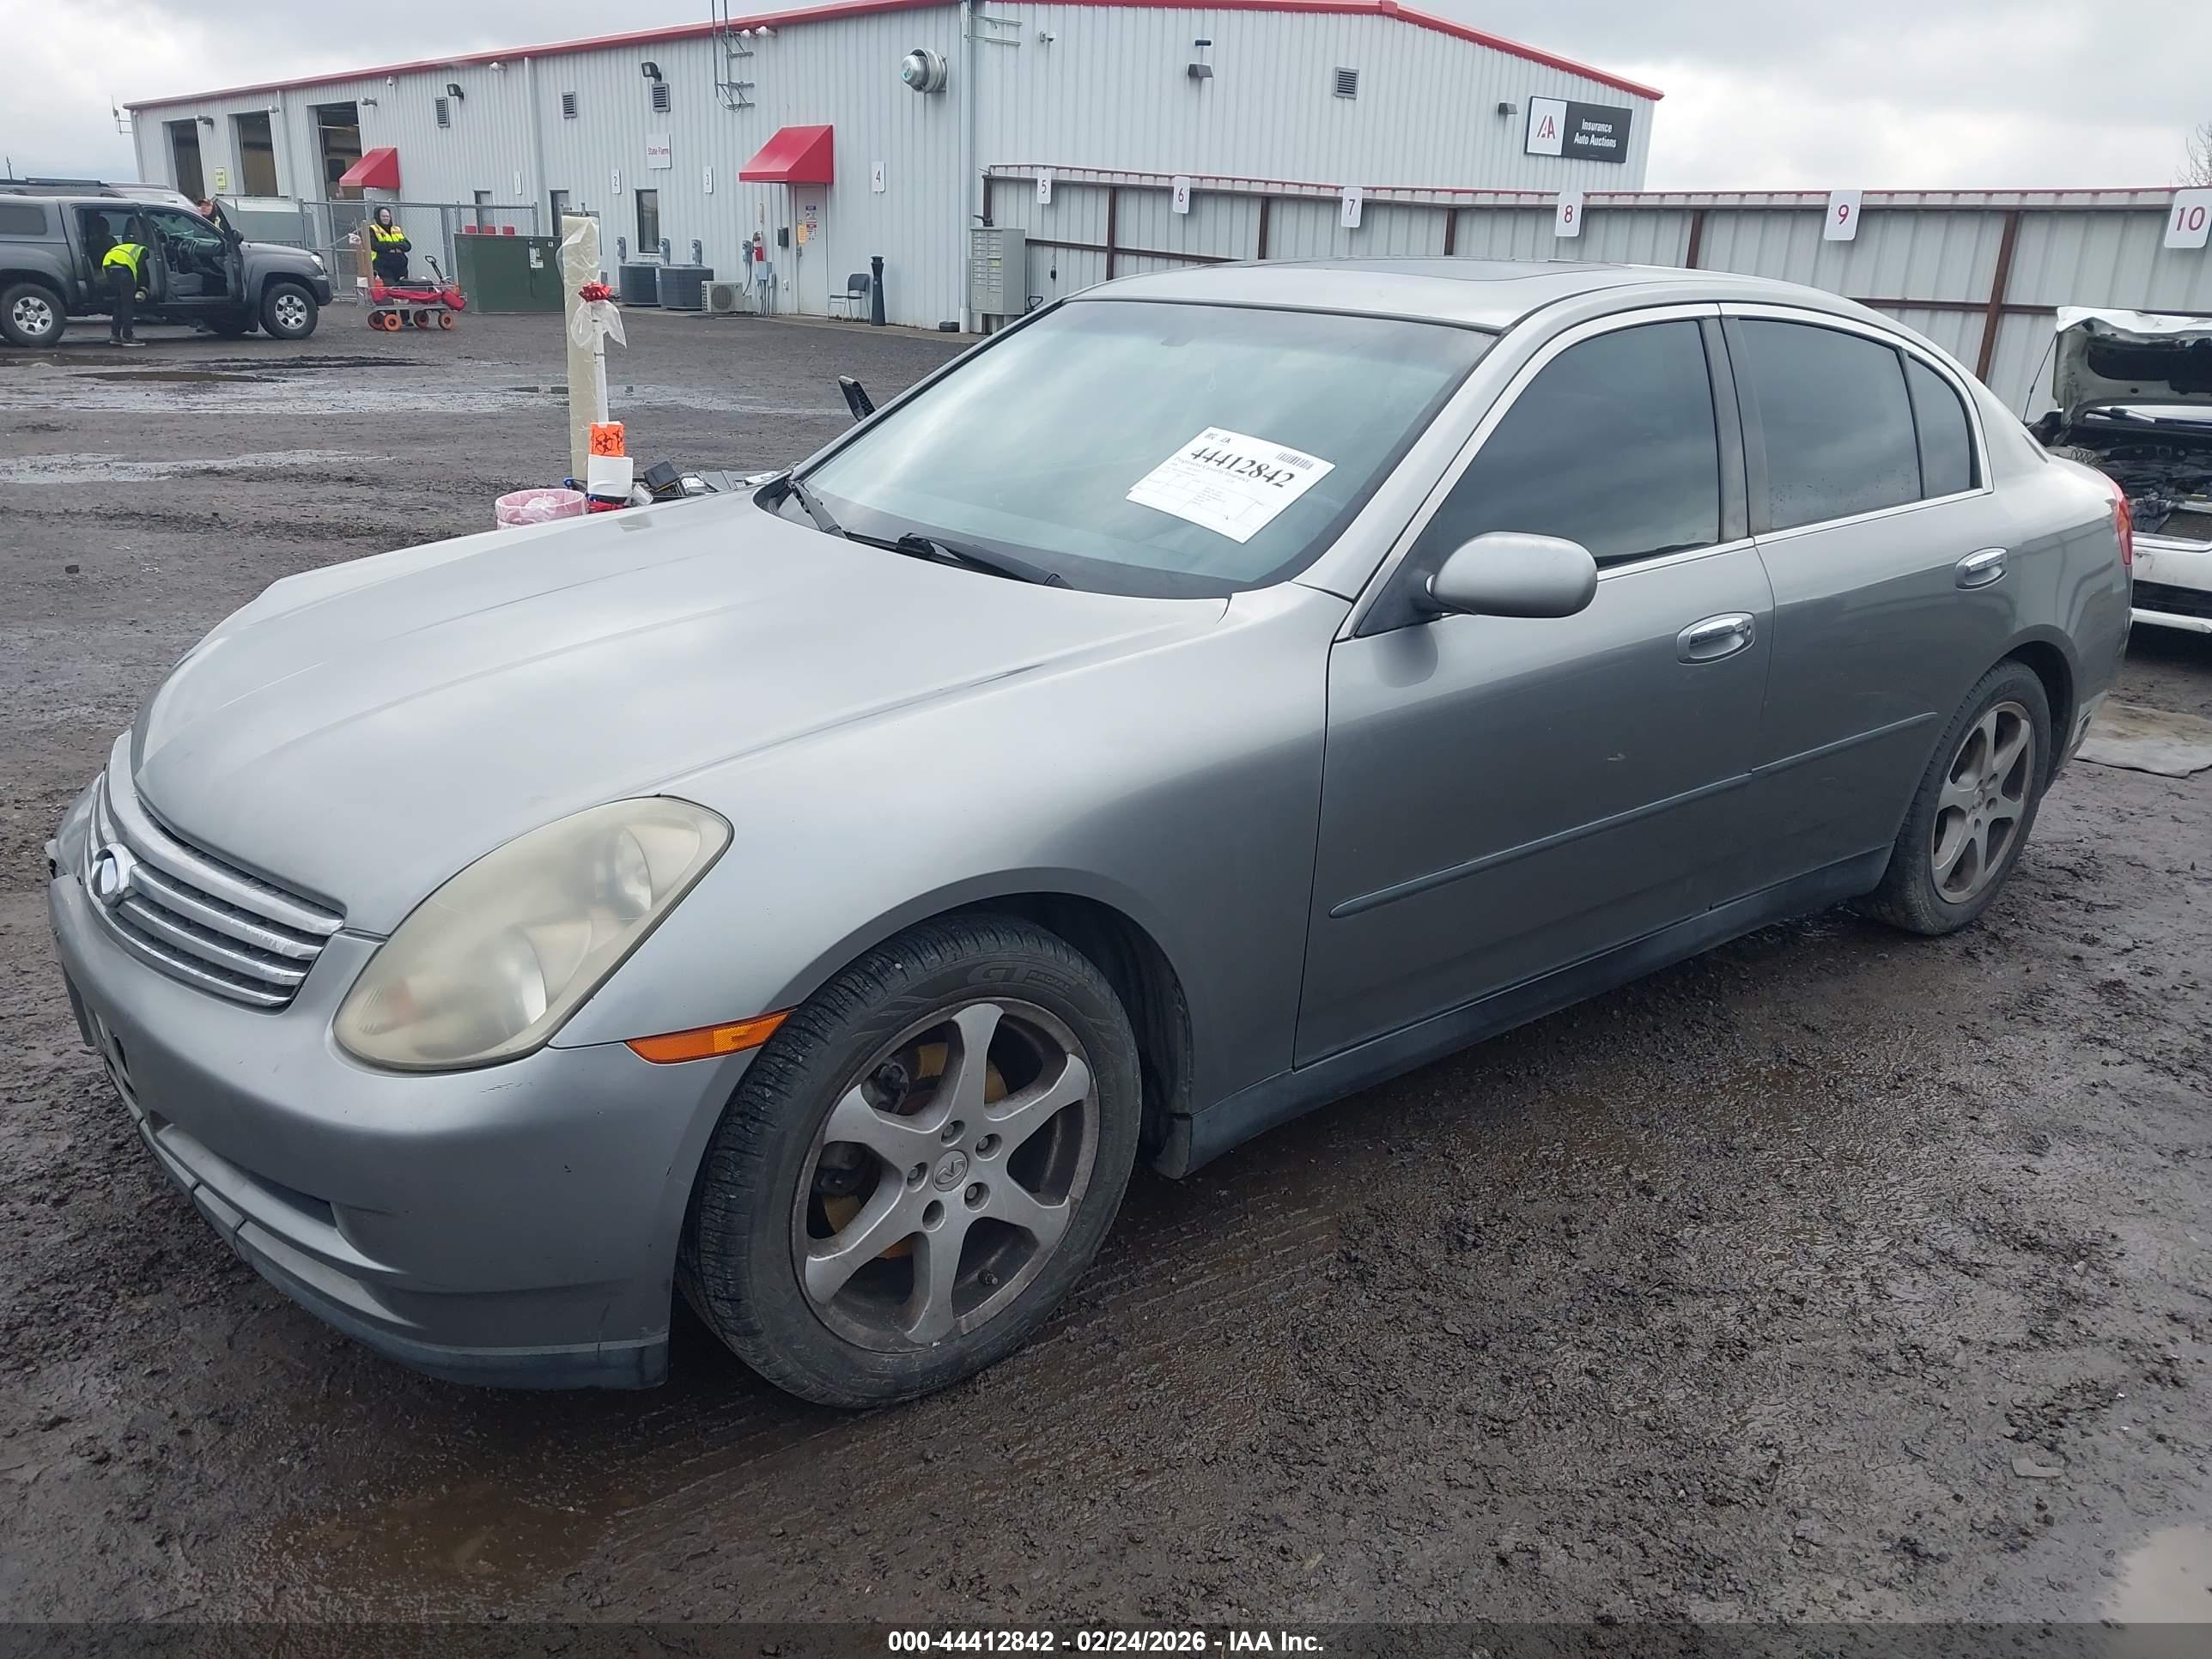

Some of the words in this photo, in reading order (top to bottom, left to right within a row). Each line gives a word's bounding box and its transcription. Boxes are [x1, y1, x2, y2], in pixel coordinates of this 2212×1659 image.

[1582, 118, 1613, 133] Insurance
[1573, 132, 1589, 145] Auto
[1589, 134, 1617, 148] Auctions
[613, 176, 617, 186] 2
[706, 173, 710, 185] 3
[875, 169, 881, 183] 4
[1041, 179, 1047, 194] 5
[1178, 187, 1184, 203] 6
[1348, 198, 1356, 216] 7
[1564, 204, 1573, 223] 8
[1838, 204, 1850, 225] 9
[2176, 206, 2206, 231] 10
[1191, 447, 1295, 488] 44412842
[967, 961, 1030, 983] GT
